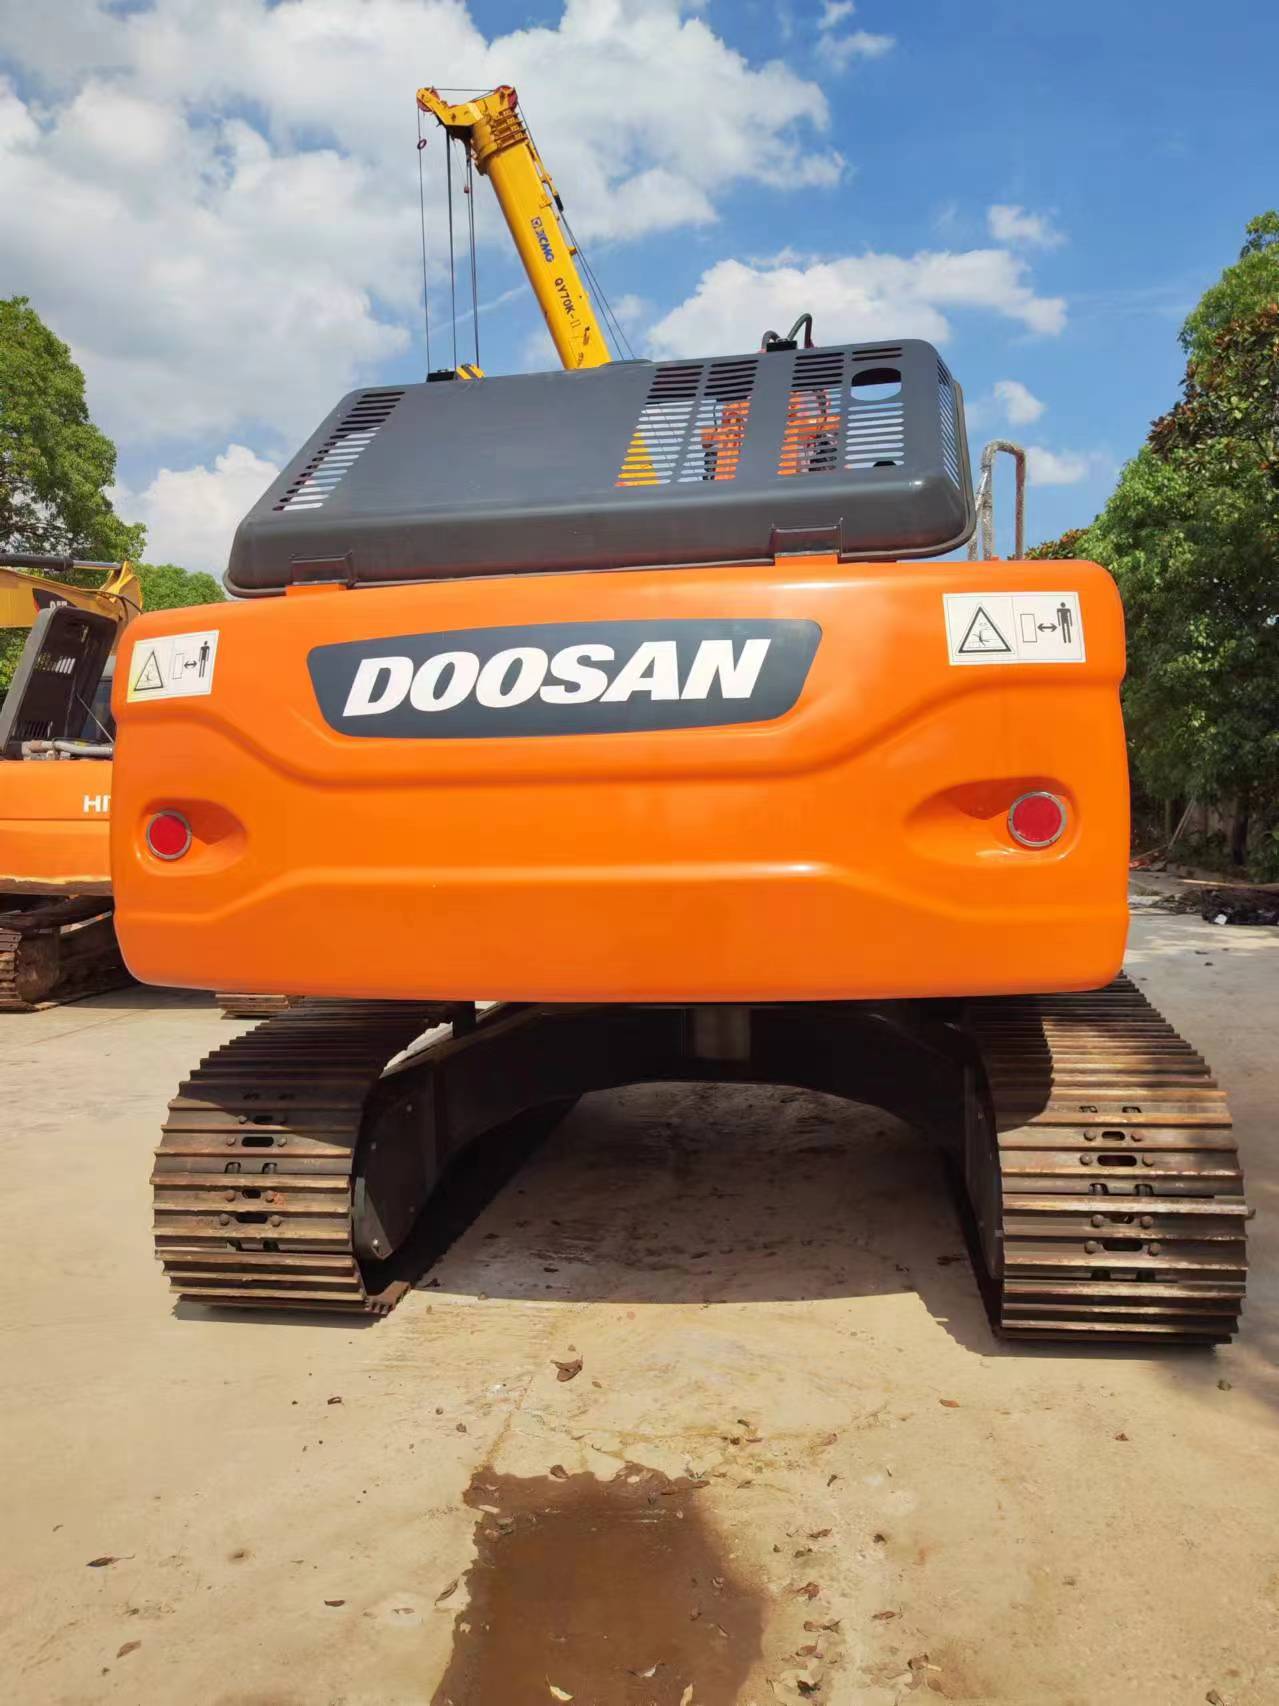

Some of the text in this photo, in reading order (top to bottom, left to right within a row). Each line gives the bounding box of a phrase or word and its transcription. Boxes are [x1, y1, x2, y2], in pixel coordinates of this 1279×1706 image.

[535, 229, 555, 263] XCMG
[342, 638, 770, 717] DOOSAN
[83, 794, 111, 813] HI
